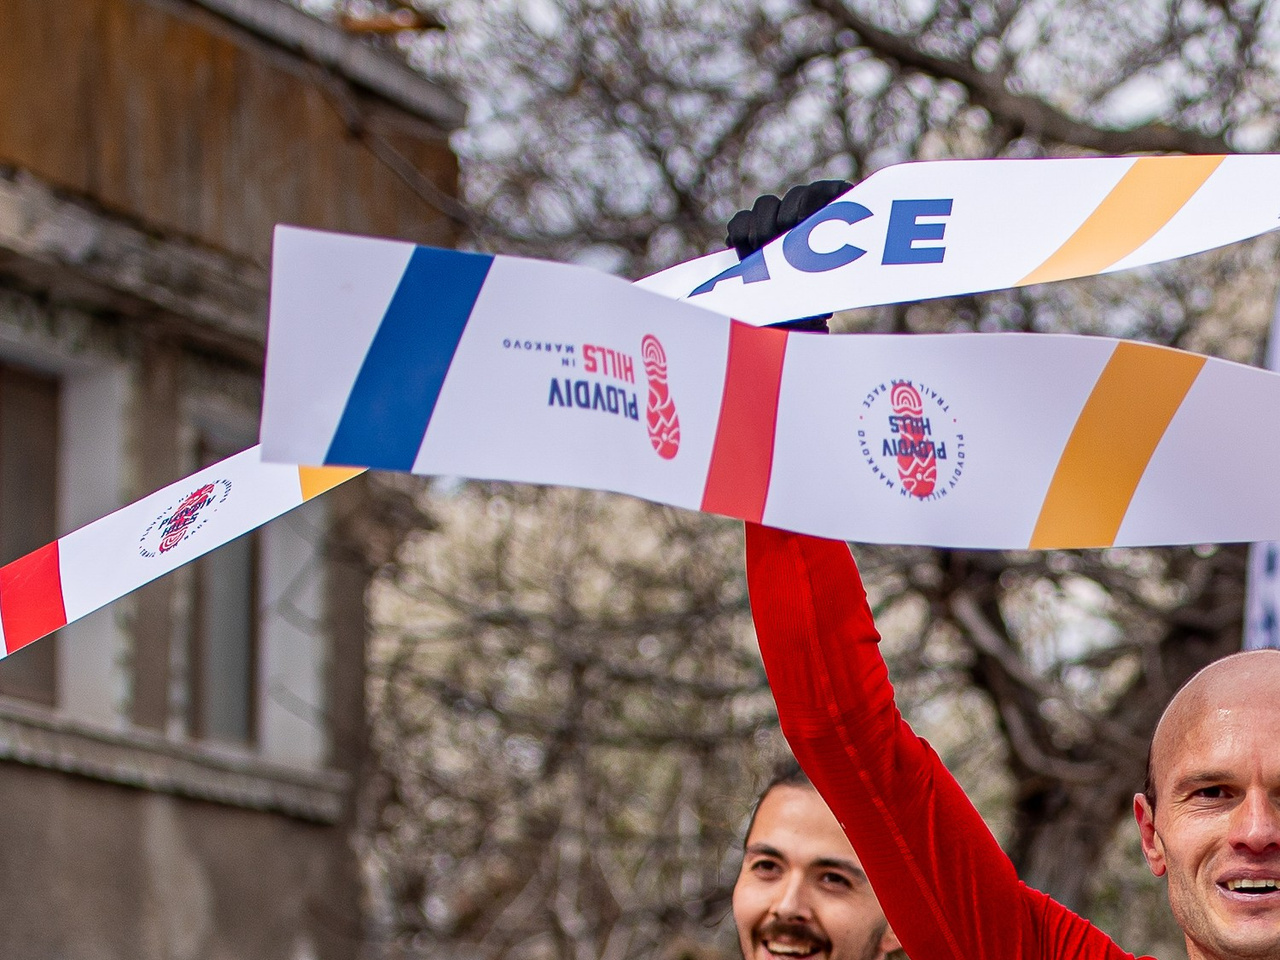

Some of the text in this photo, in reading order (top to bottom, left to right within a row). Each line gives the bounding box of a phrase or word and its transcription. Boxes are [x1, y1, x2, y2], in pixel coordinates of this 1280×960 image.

[503, 338, 574, 354] MARKOVO
[562, 358, 575, 367] IN
[582, 344, 635, 384] HILLS
[548, 378, 639, 422] PLOVDIV
[888, 415, 931, 436] HILLS
[882, 439, 947, 459] PLOVDIV
